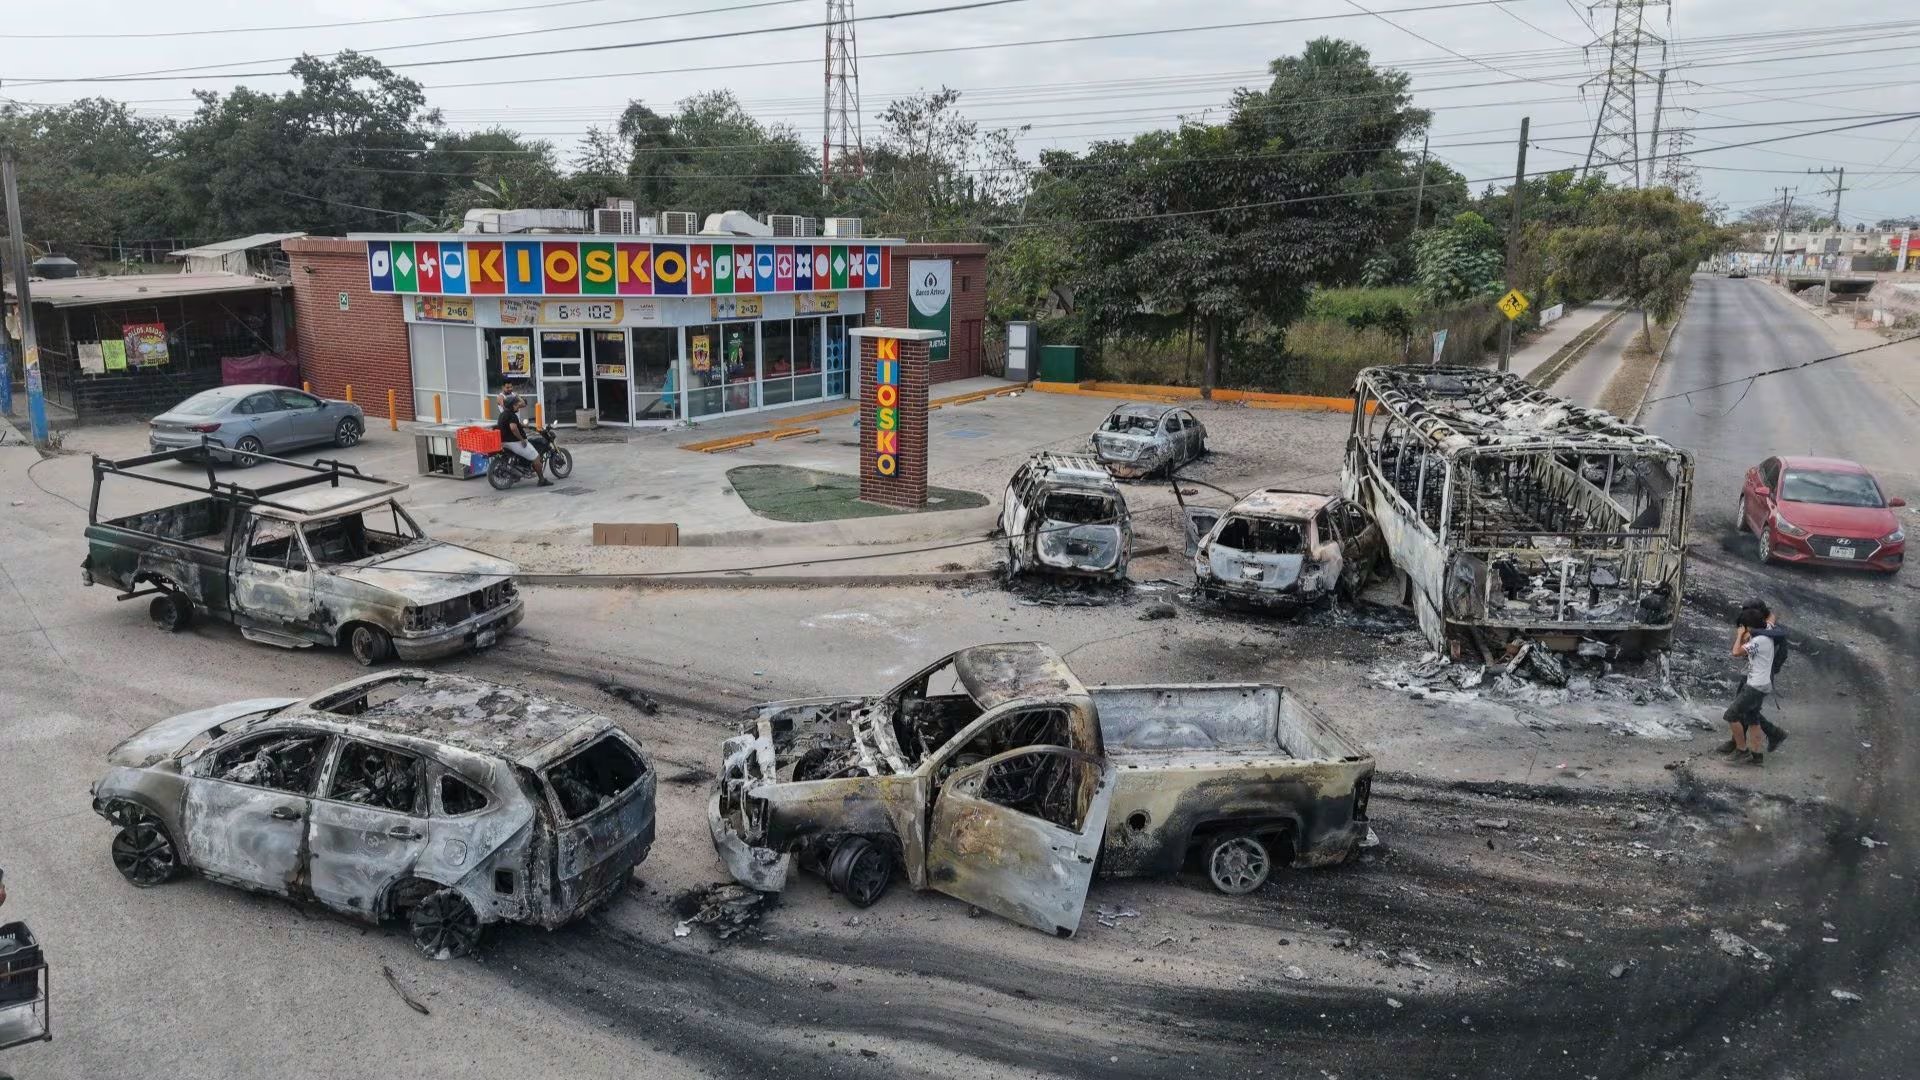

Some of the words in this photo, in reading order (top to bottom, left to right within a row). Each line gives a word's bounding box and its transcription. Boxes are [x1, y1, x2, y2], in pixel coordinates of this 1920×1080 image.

[468, 249, 687, 284] KIOSKO
[930, 288, 945, 296] Azteca
[559, 305, 569, 319] 6
[588, 305, 612, 319] 102
[877, 338, 897, 475] KIOSKO
